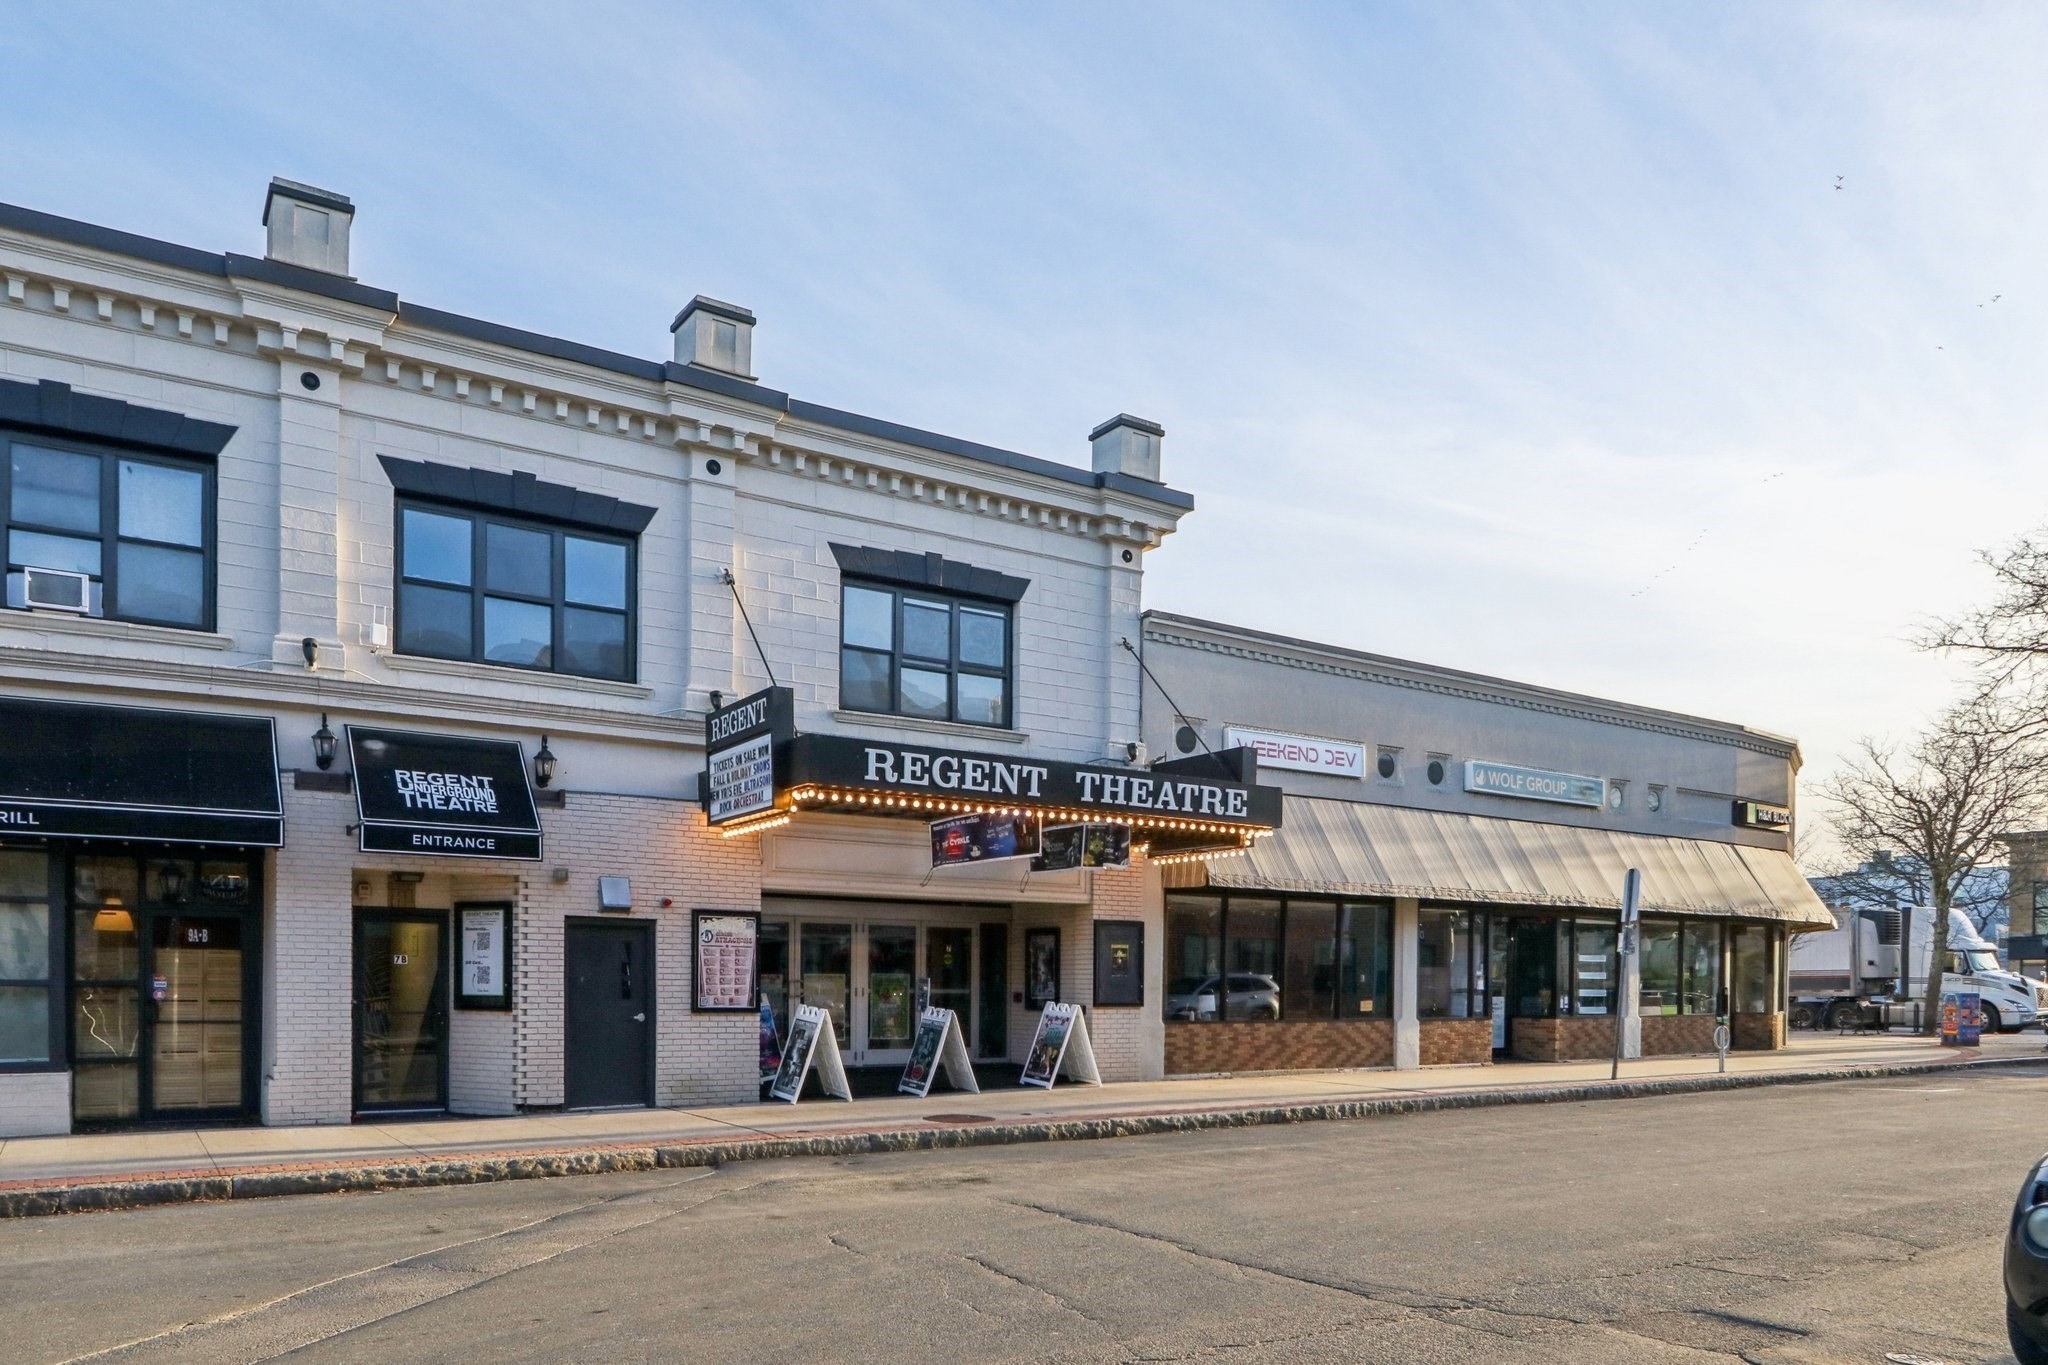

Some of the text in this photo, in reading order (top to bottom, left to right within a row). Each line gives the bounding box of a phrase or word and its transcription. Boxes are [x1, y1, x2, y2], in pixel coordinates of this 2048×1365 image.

[711, 697, 767, 742] REGENT
[713, 744, 770, 774] TICKETS ON SALE NOW
[1325, 749, 1357, 768] DEV
[395, 769, 493, 789] REGENT
[713, 774, 726, 788] FALL
[731, 765, 752, 782] HOLIDAY
[753, 758, 770, 775] SHOWS
[863, 747, 1249, 818] REGENT THEATRE
[1487, 770, 1523, 789] WOLF
[1526, 776, 1567, 795] GROUP
[397, 779, 496, 803] UNDERGROUND
[398, 789, 499, 813] THEATRE
[733, 783, 743, 795] EVE
[719, 800, 732, 814] ROCK
[412, 834, 496, 850] ENTRANCE
